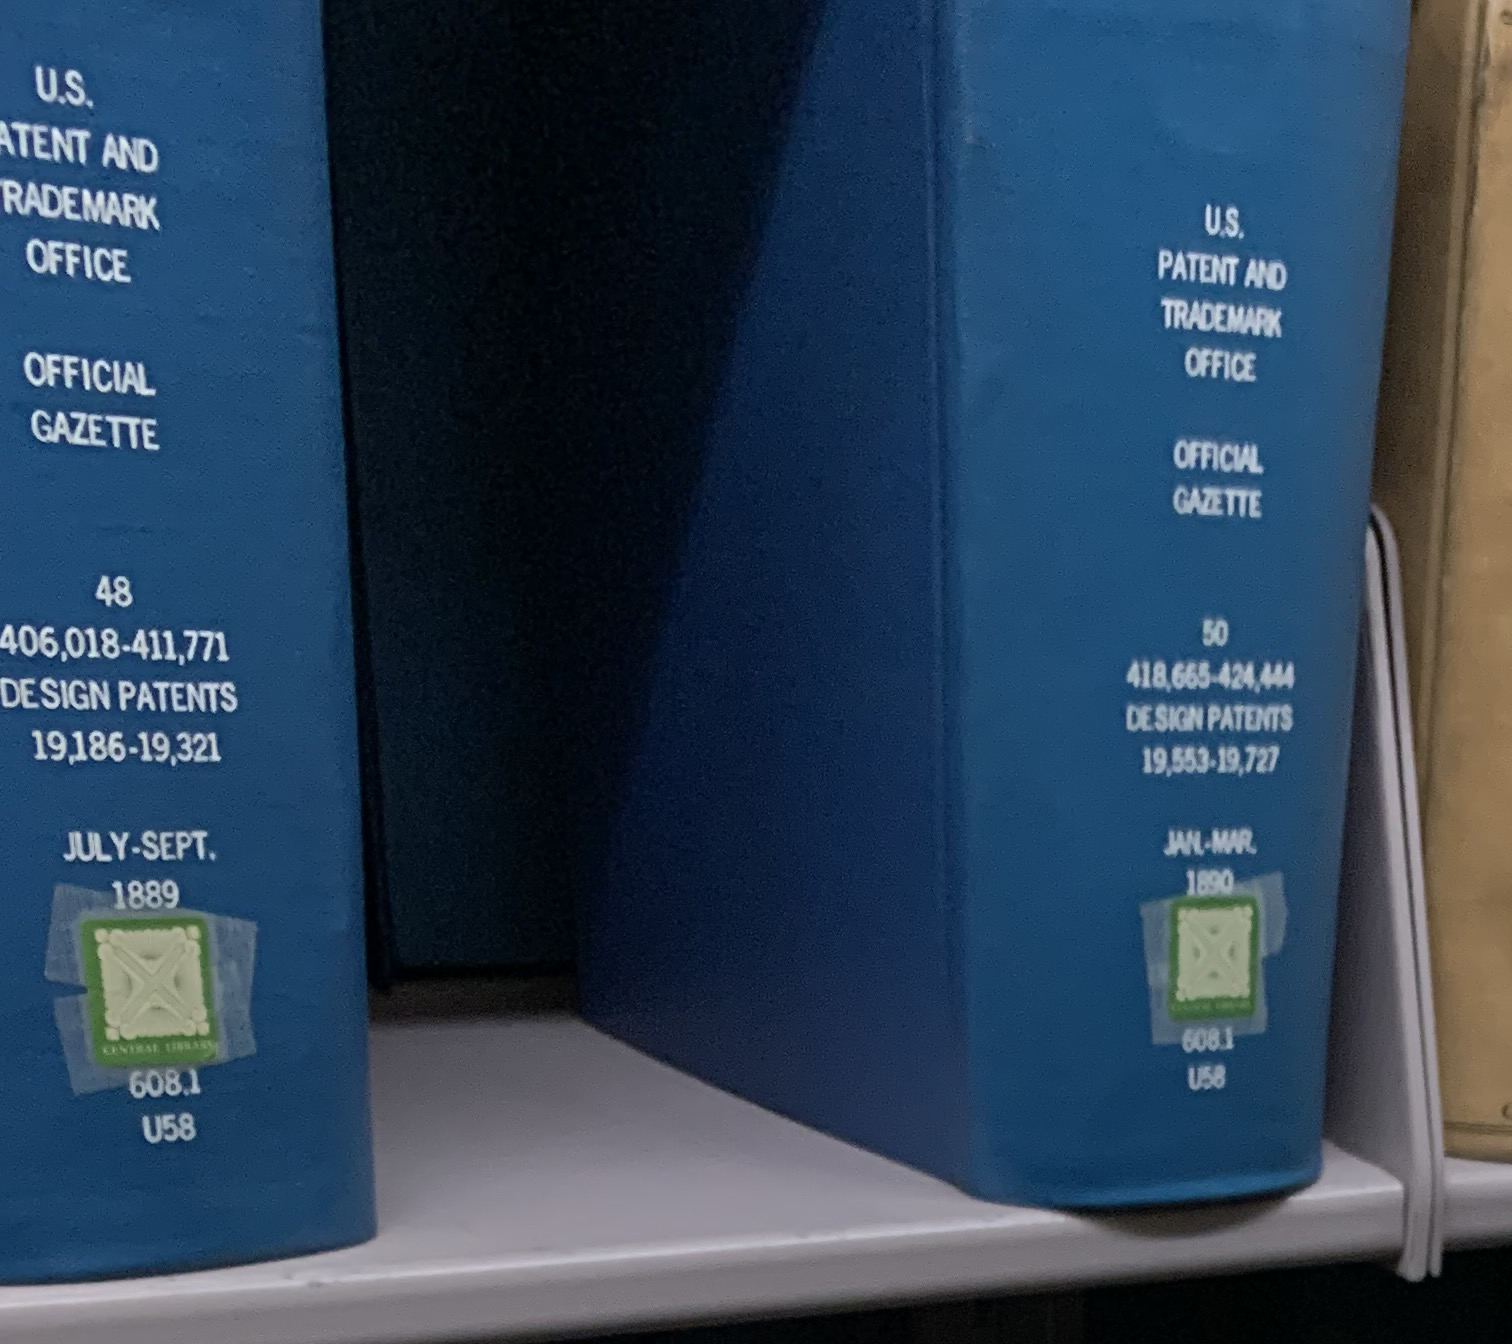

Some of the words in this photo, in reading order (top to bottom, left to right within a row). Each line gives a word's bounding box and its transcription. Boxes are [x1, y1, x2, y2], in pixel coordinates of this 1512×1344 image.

[35, 66, 92, 108] U.S.
[103, 133, 159, 172] AND
[1204, 204, 1244, 239] U.S.
[26, 238, 132, 283] OFFICE
[1158, 250, 1239, 285] PATENT
[1244, 257, 1287, 291] AND
[1161, 297, 1282, 337] TRADEMARK
[24, 353, 156, 395] OFFICIAL
[1185, 348, 1257, 382] OFFICE
[31, 410, 159, 450] GAZETTE
[1174, 439, 1263, 474] OFFICIAL
[1173, 487, 1261, 517] GAZETTE
[96, 576, 132, 607] 48
[0, 626, 229, 667] 406,018-411,771
[1203, 619, 1228, 646] 50
[0, 677, 110, 711] DESIGN
[119, 681, 238, 713] PATENTS
[1126, 704, 1201, 731] DESIGN
[1208, 705, 1293, 732] PATENTS
[32, 730, 221, 766] 19,186-19,321
[63, 831, 216, 862] JULY-SEPT.
[112, 880, 179, 910] 1889
[1182, 1028, 1233, 1051] 608.1
[129, 1069, 201, 1099] 608.1
[142, 1112, 196, 1144] U58
